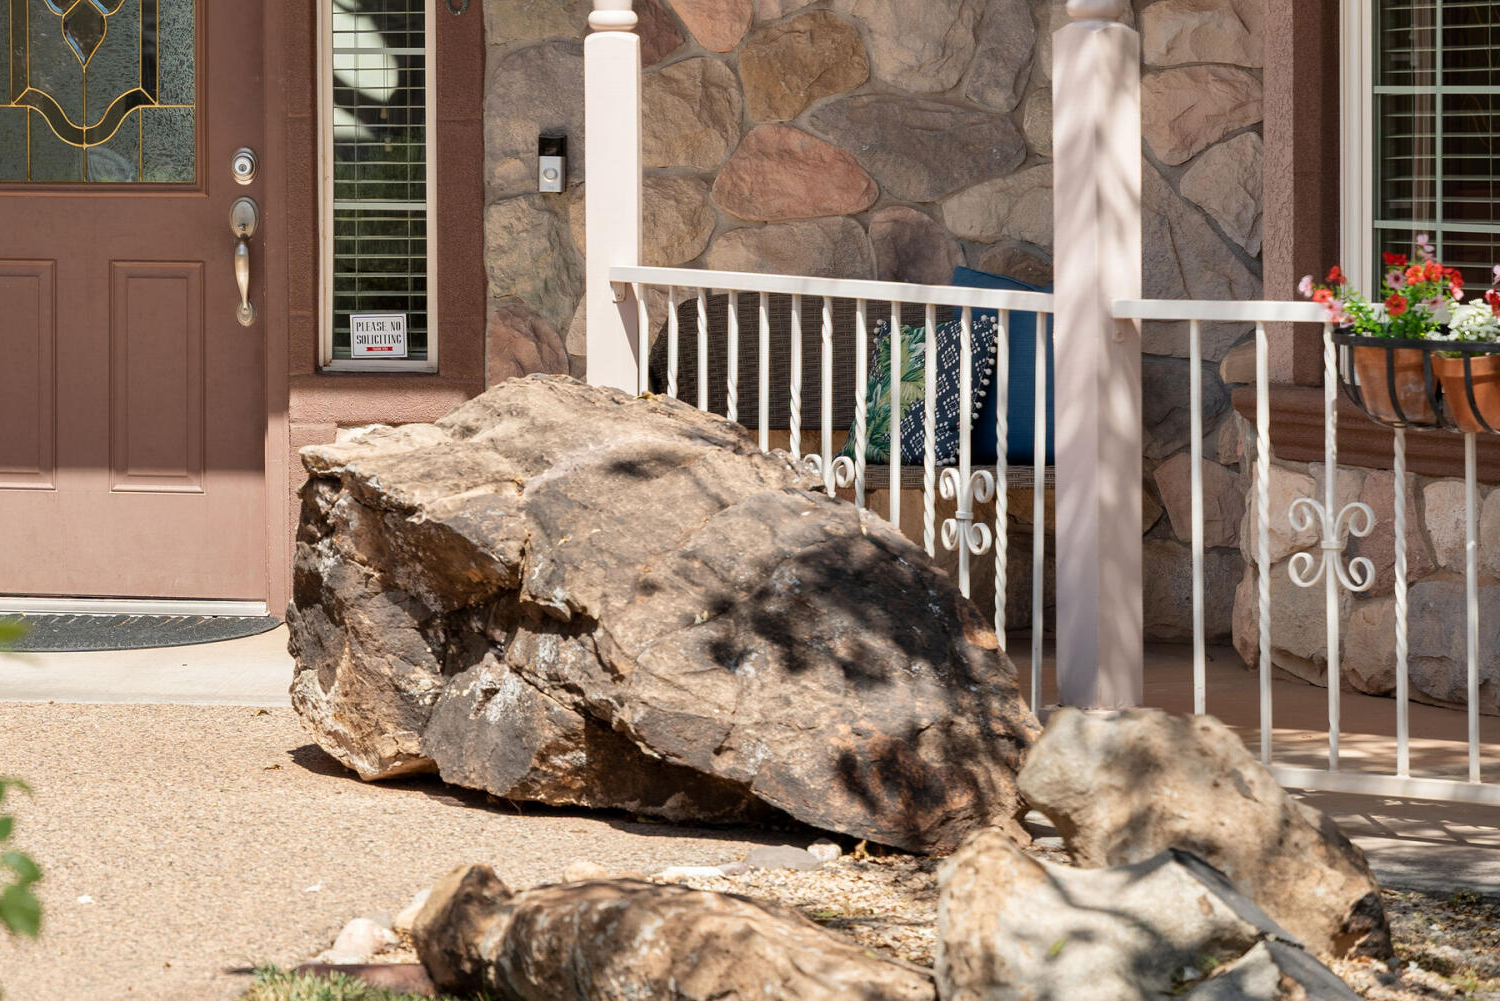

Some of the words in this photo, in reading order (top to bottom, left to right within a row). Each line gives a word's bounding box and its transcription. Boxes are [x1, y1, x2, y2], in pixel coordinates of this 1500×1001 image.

[356, 321, 386, 332] PLEASE
[390, 321, 401, 331] NO
[356, 334, 402, 345] SOLICITING
